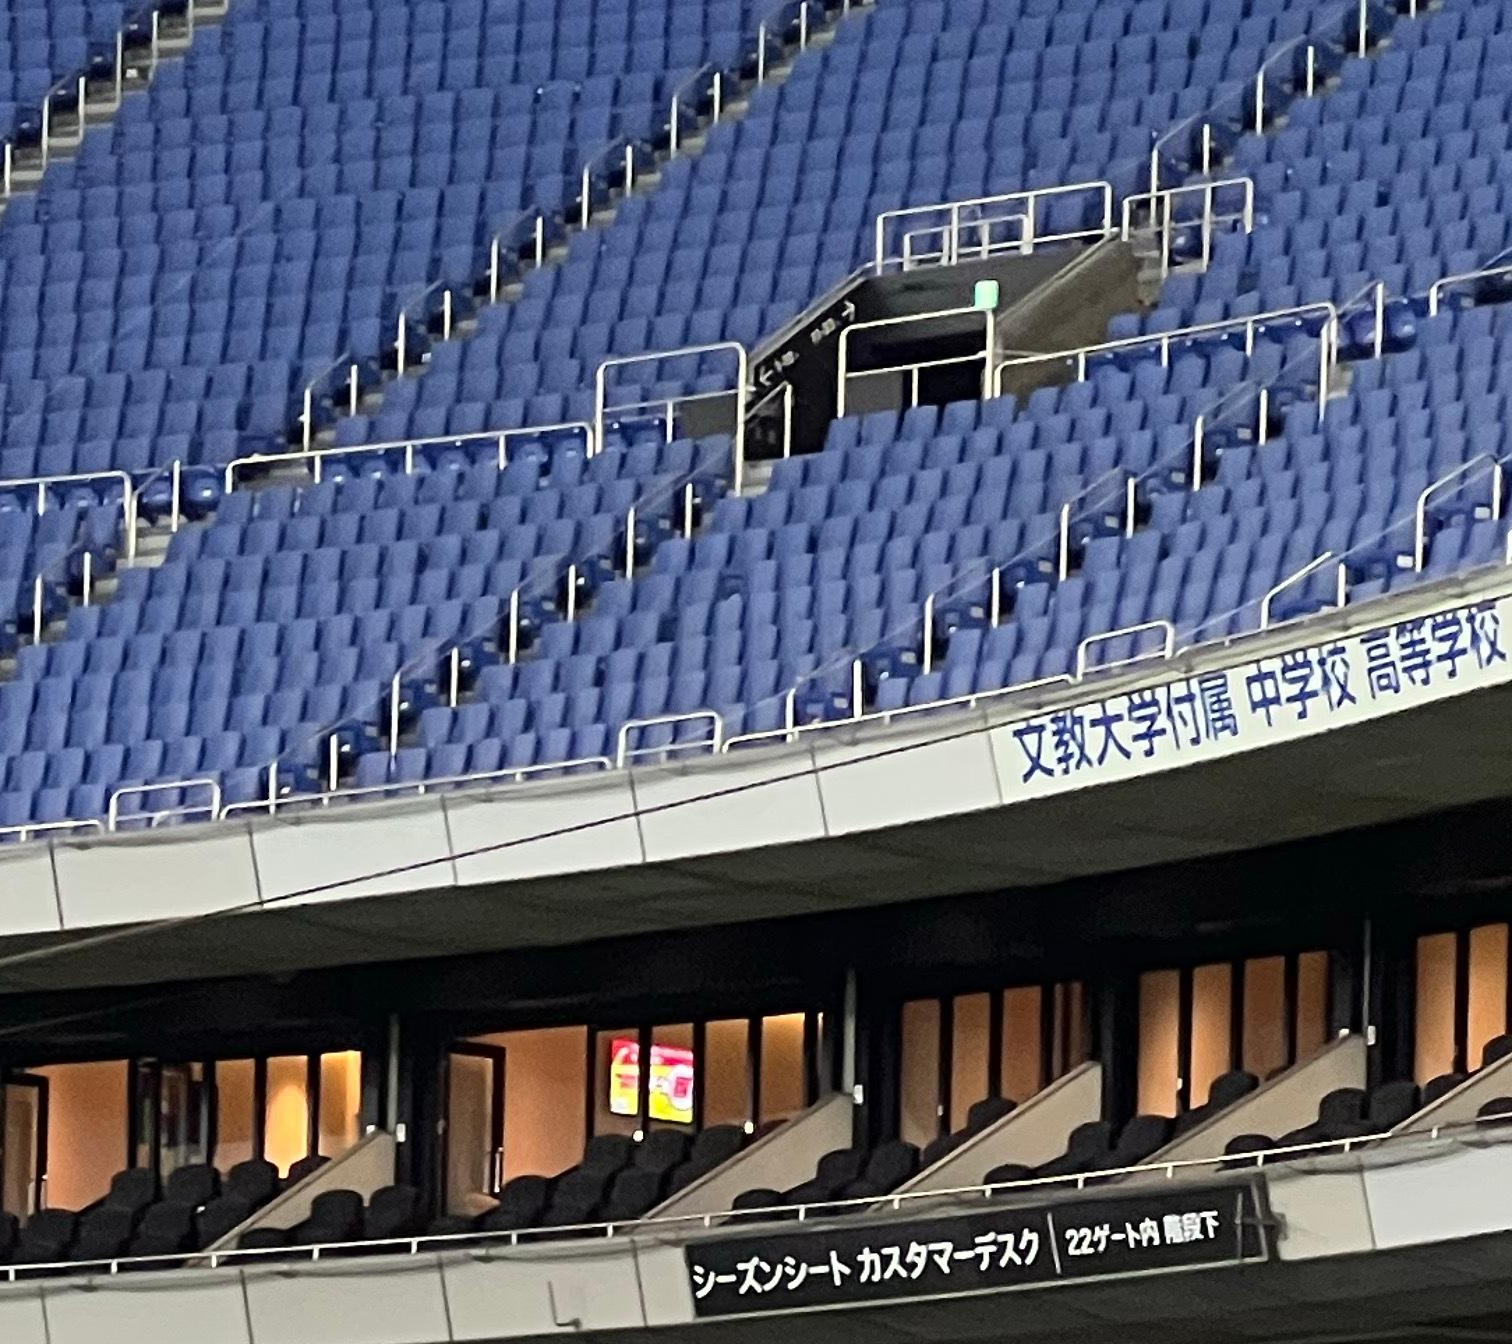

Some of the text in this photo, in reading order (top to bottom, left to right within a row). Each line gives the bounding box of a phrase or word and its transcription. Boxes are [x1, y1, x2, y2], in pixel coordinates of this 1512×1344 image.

[1013, 599, 1507, 783] 文教大学付属 中学校 高等学校
[692, 1249, 852, 1299] シーズンシート
[856, 1227, 1039, 1284] カスタマーデスク
